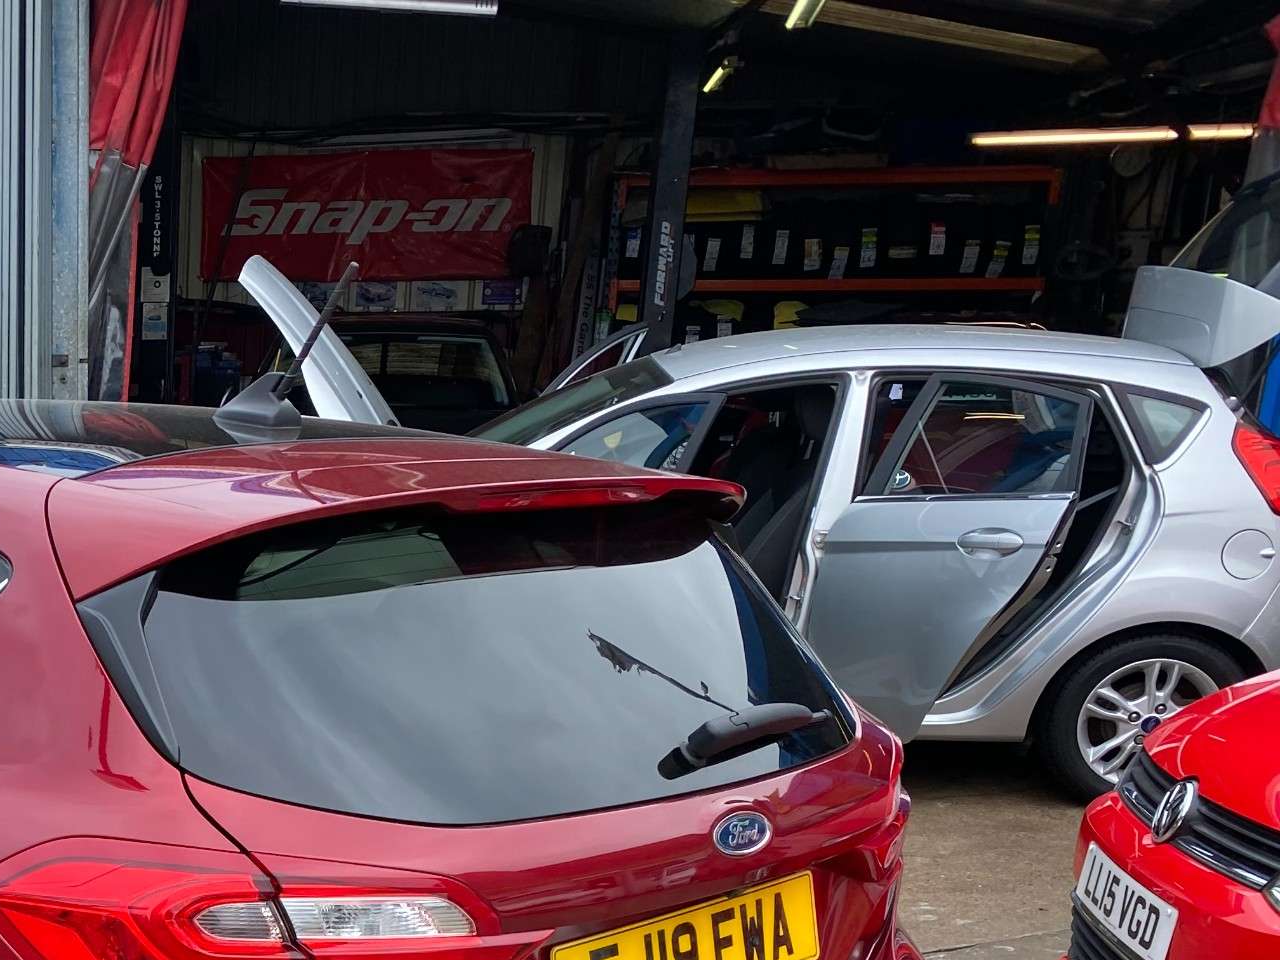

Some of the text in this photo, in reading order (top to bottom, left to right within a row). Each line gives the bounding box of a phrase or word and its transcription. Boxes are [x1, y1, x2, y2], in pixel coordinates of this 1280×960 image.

[221, 188, 513, 245] Snap-on
[654, 220, 672, 306] FORWARD
[729, 820, 761, 847] Ford
[1084, 855, 1161, 951] LL15 VGD
